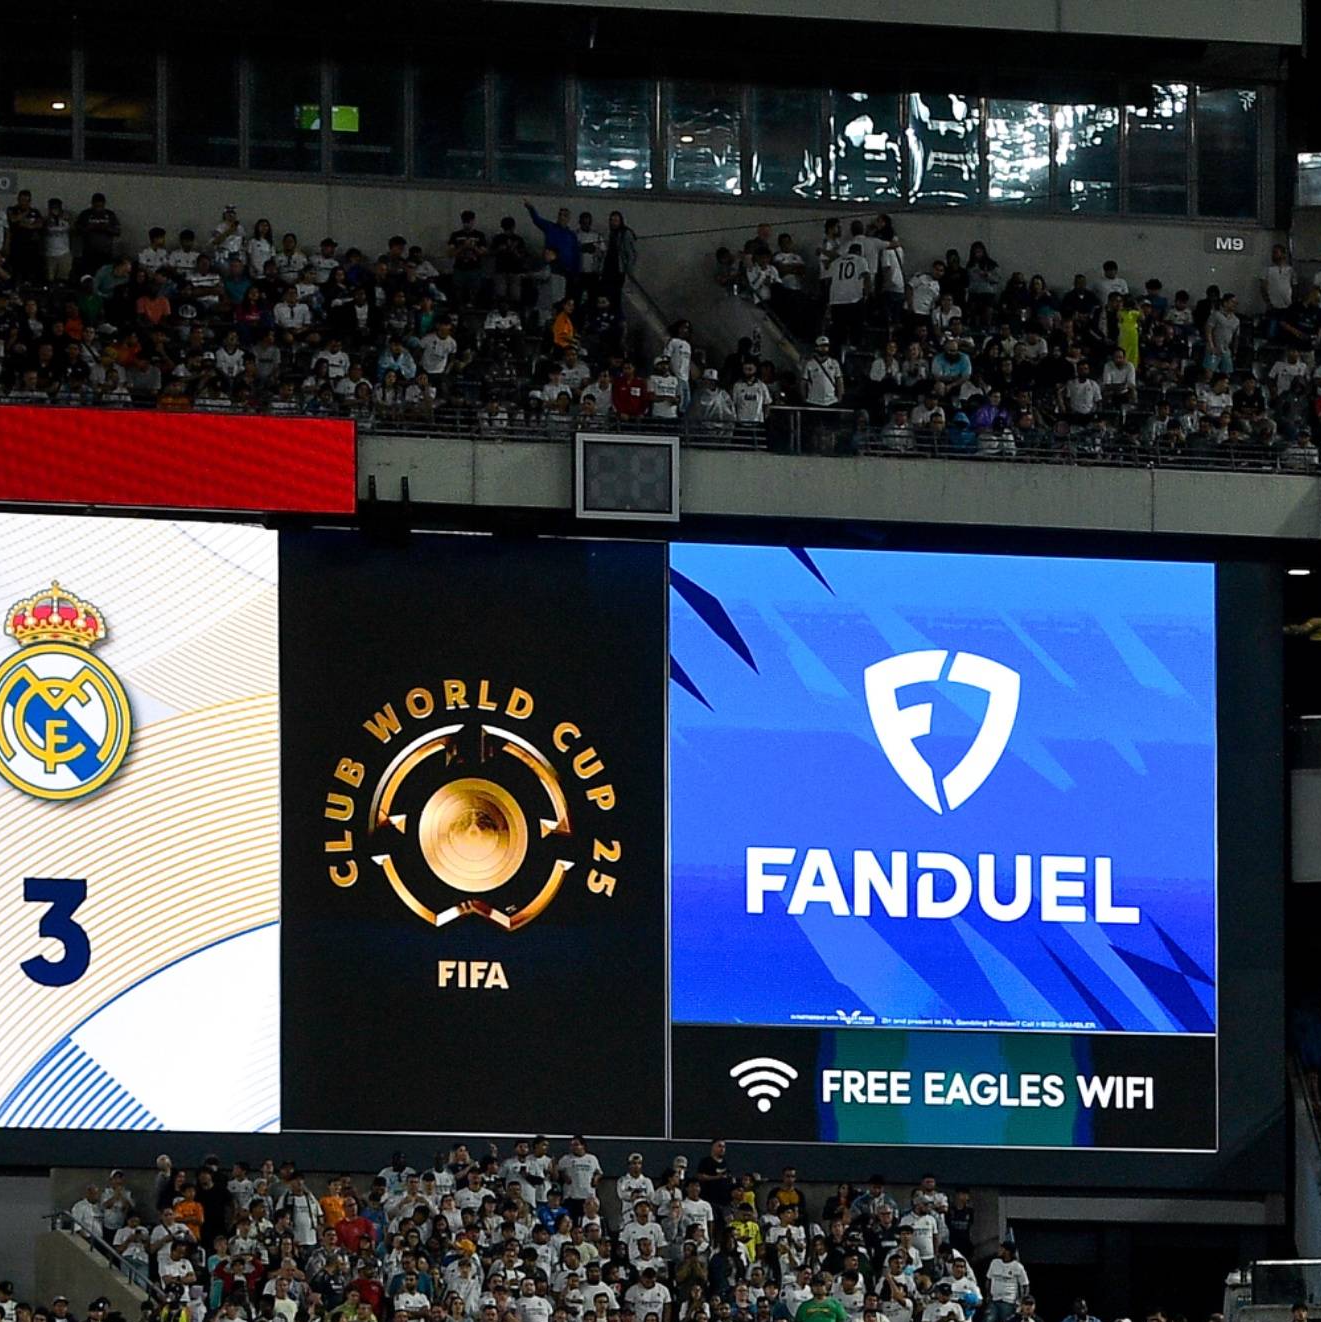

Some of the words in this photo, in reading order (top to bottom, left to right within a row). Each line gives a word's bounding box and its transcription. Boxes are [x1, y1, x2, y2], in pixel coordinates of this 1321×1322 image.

[1215, 237, 1244, 252] M9
[836, 261, 855, 281] 10
[324, 757, 366, 888] CLUB
[362, 679, 535, 744] WORLD
[551, 720, 616, 812] CUP
[585, 838, 622, 898] 25
[745, 845, 1141, 926] FANDUEL
[20, 877, 91, 987] 3
[437, 960, 509, 989] FIFA
[821, 1068, 914, 1106] FREE
[923, 1069, 1065, 1108] EAGLES
[1077, 1074, 1155, 1111] WIFI
